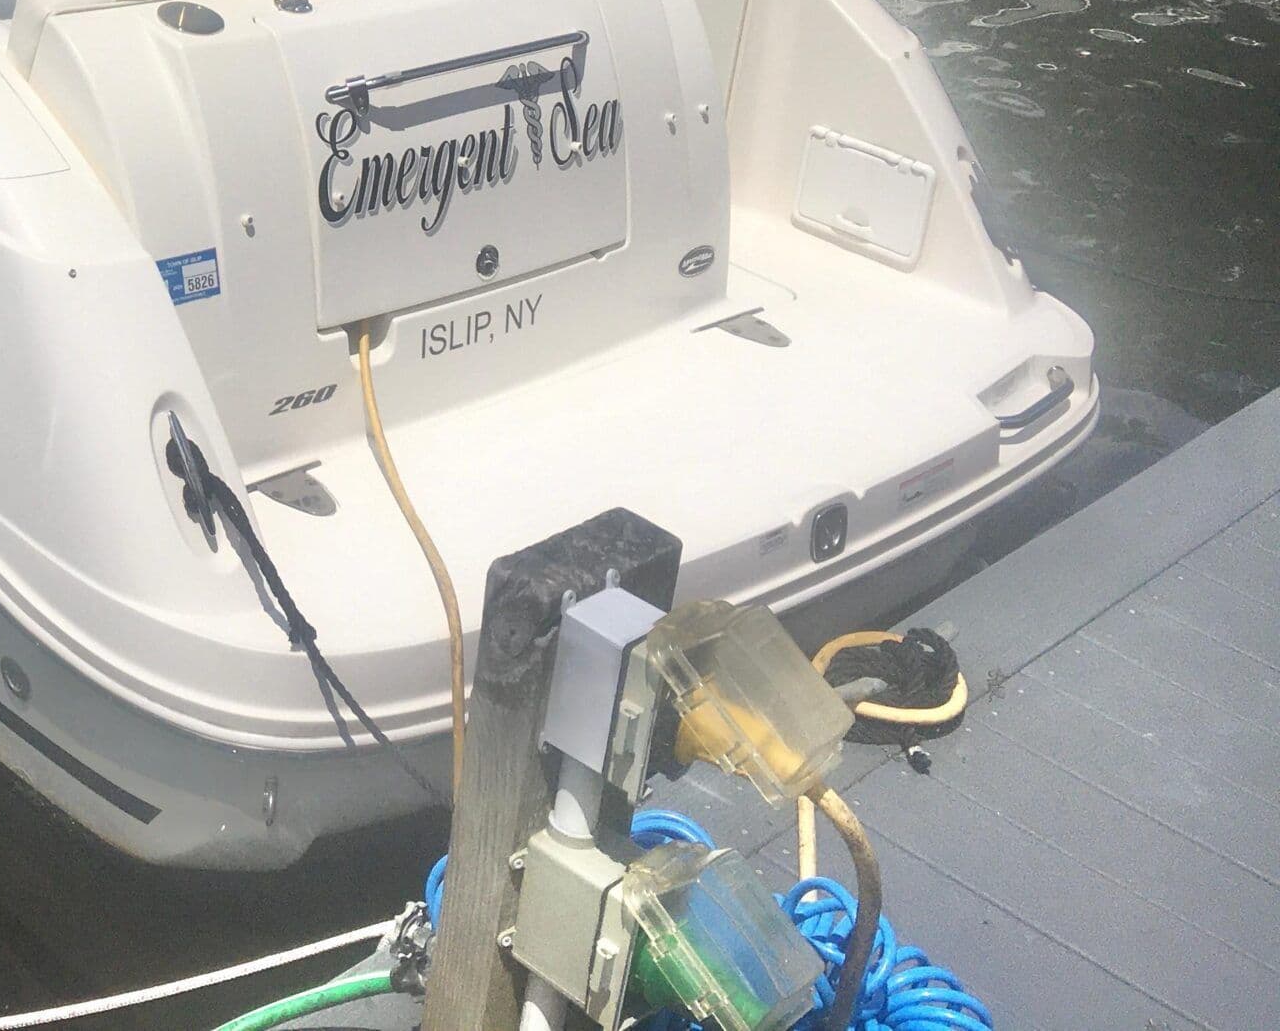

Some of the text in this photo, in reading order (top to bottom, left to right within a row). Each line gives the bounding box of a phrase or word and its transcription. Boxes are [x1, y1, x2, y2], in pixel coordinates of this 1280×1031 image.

[315, 56, 623, 236] Emergent Sea
[187, 274, 215, 292] 5826
[421, 294, 543, 359] ISLIP, NY
[269, 384, 338, 416] 260
